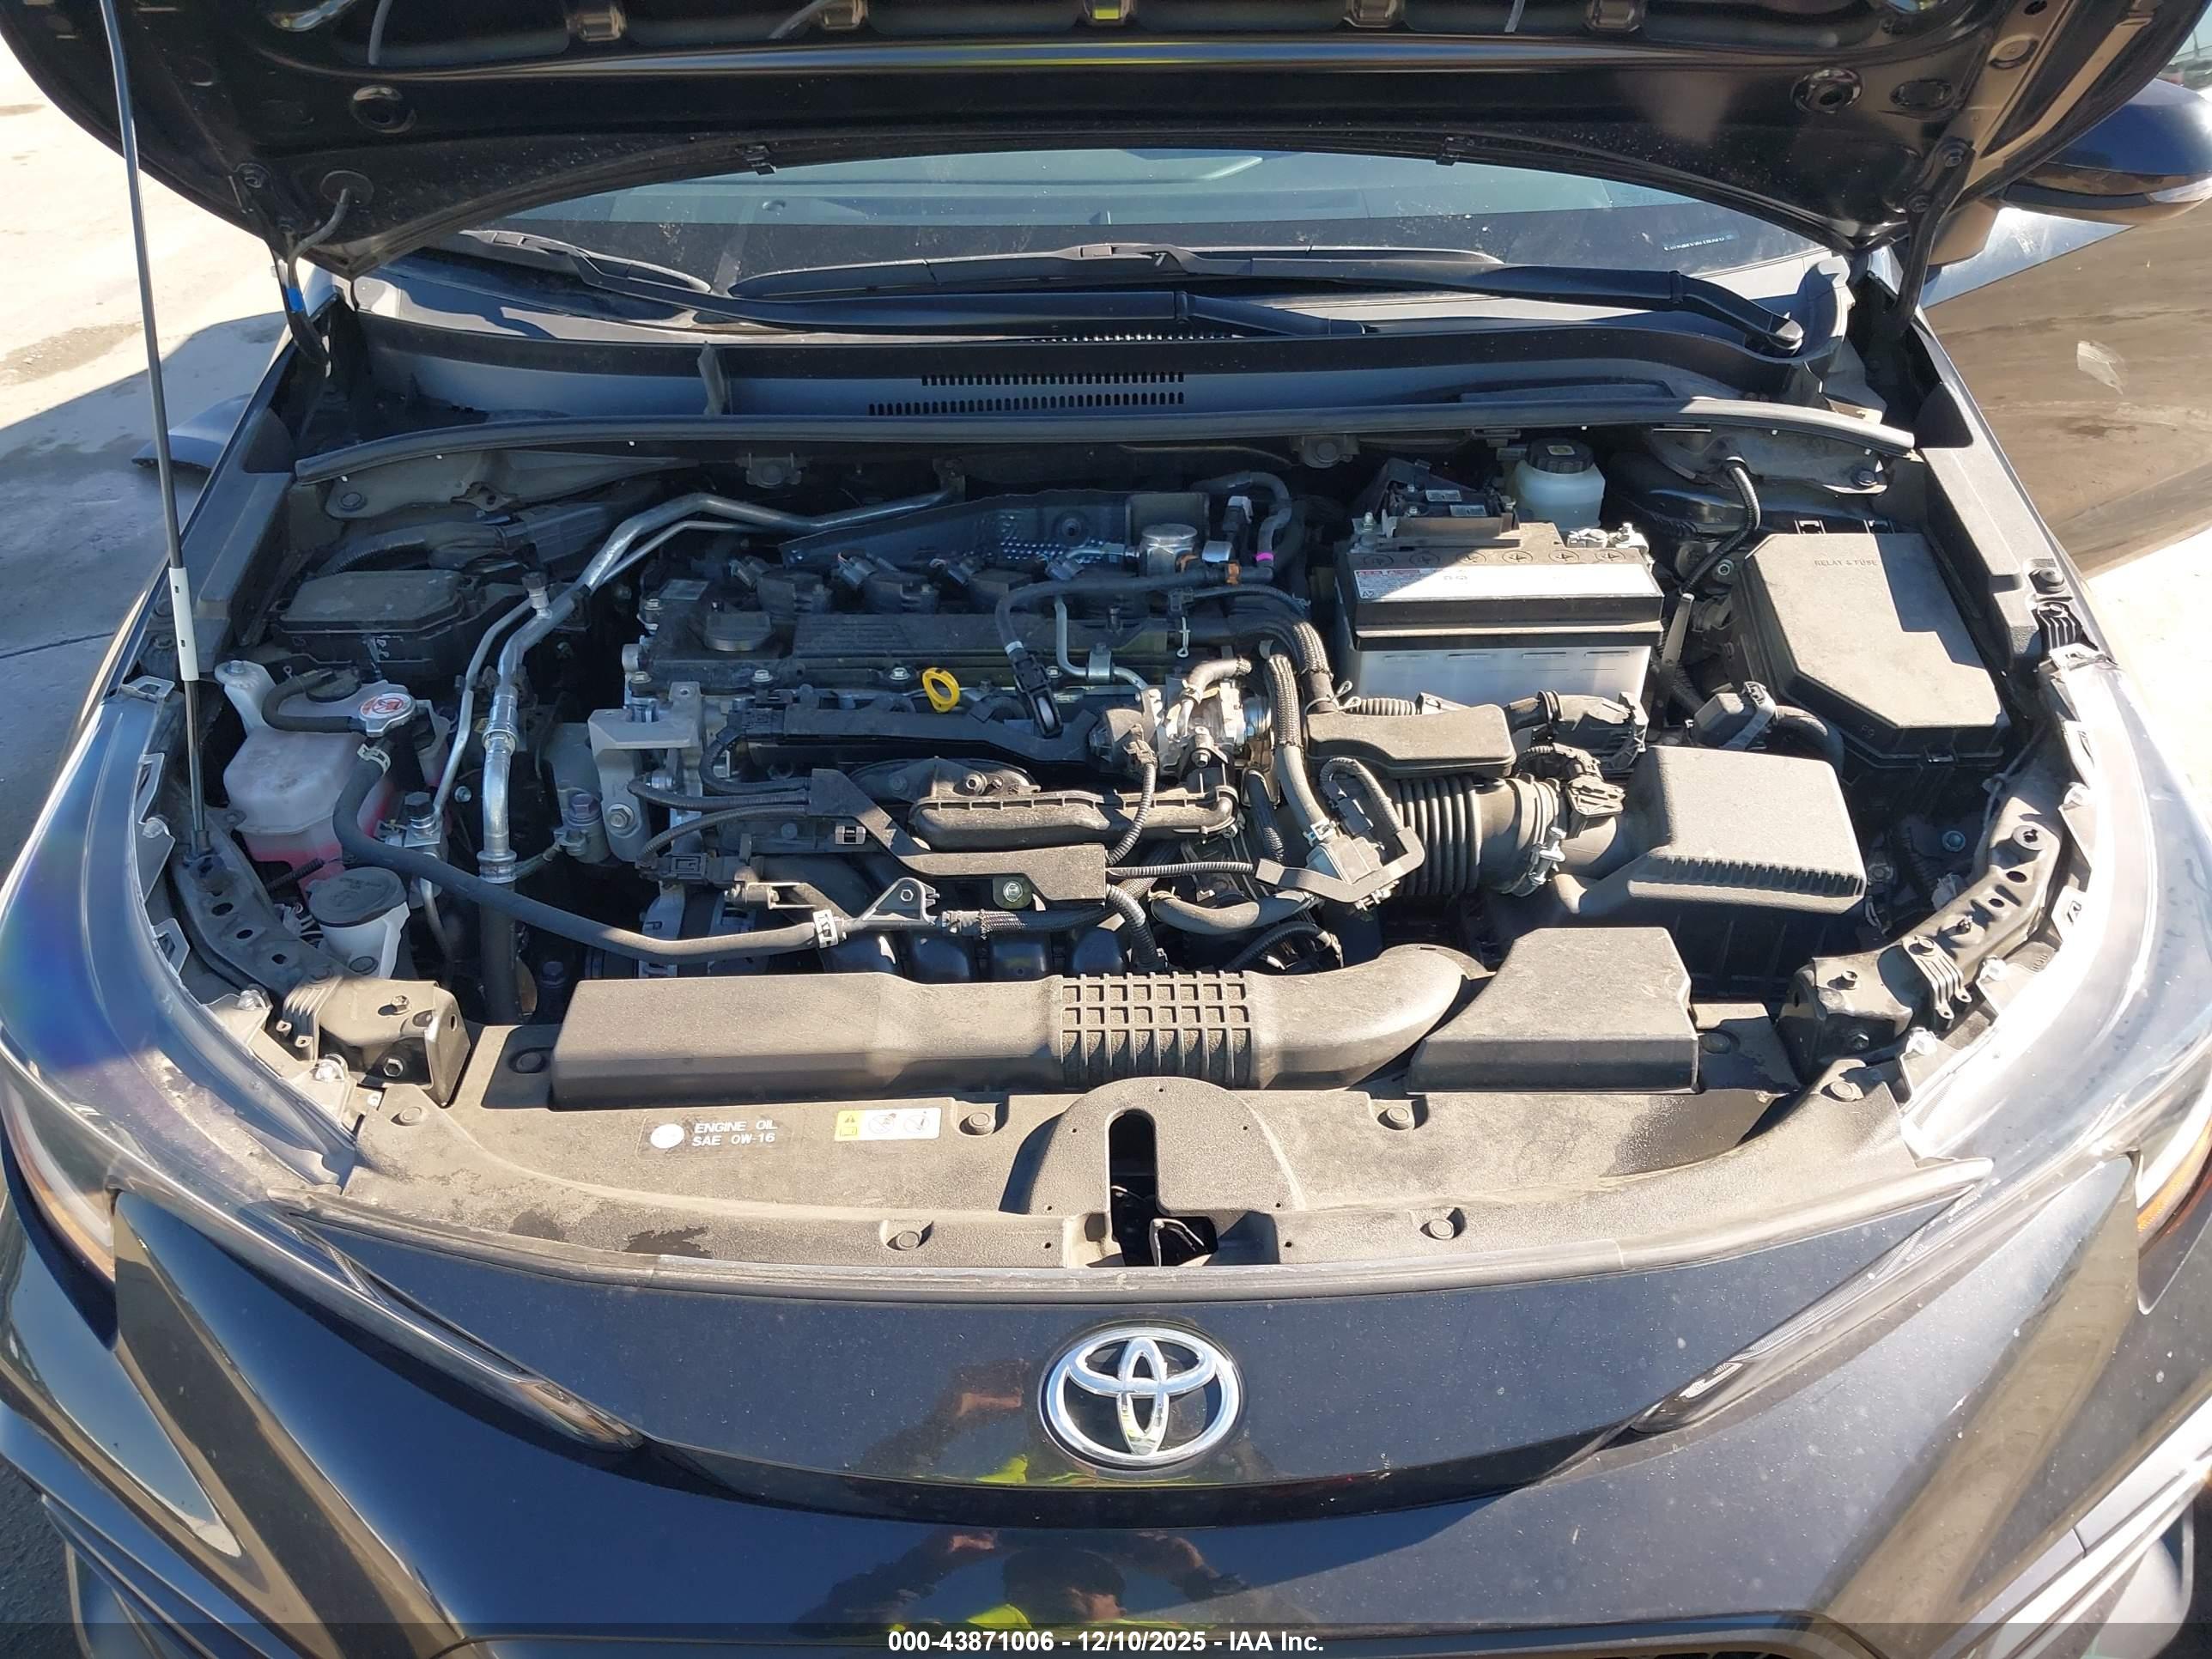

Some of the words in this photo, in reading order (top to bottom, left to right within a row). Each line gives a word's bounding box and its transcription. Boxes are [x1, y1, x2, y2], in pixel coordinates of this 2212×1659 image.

[694, 1121, 747, 1133] ENGINE
[755, 1119, 778, 1131] OIL
[692, 1135, 722, 1147] SAE
[731, 1133, 776, 1146] 0W-16
